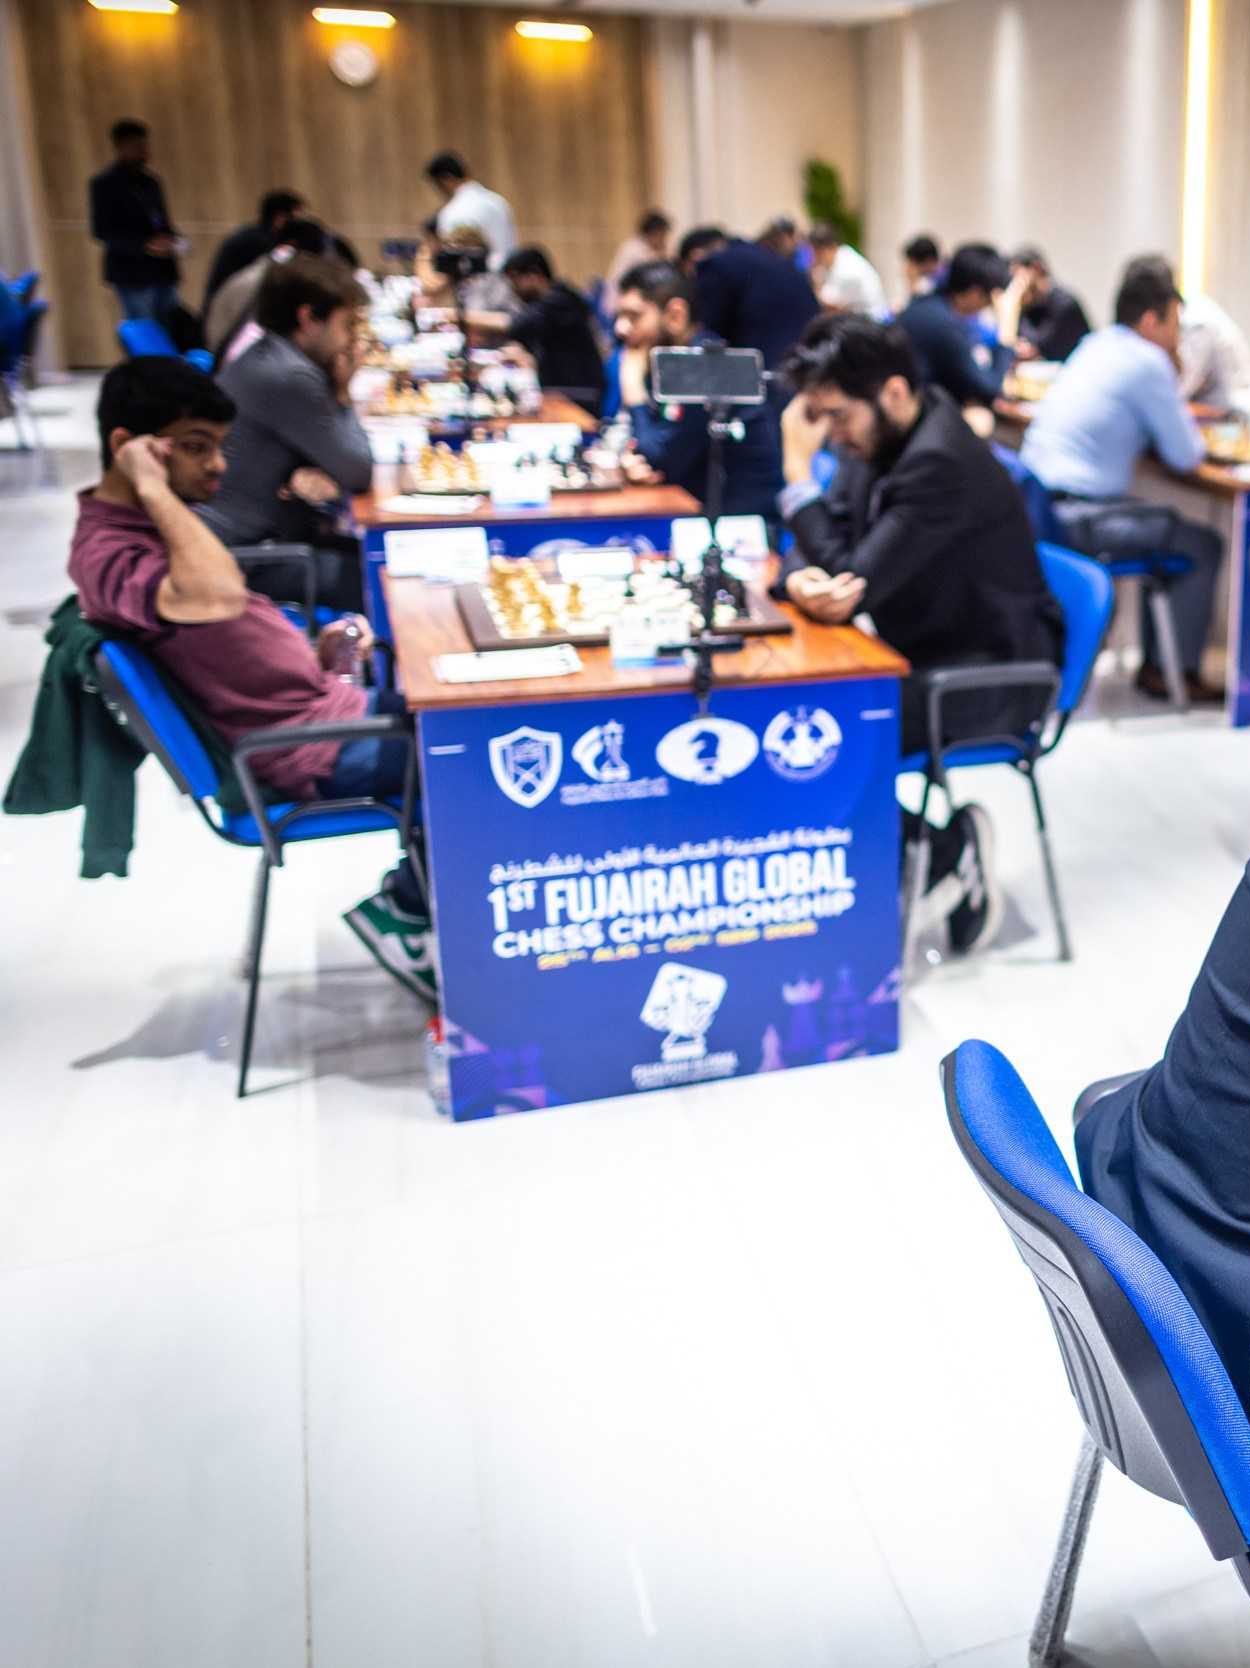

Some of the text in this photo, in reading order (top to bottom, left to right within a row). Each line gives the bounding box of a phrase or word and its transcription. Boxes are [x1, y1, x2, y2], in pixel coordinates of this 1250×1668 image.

[487, 846, 856, 932] 1ST FUJAIRAH GLOBAL
[492, 919, 605, 958] CHESS
[608, 890, 856, 944] CHAMPIONSHIP
